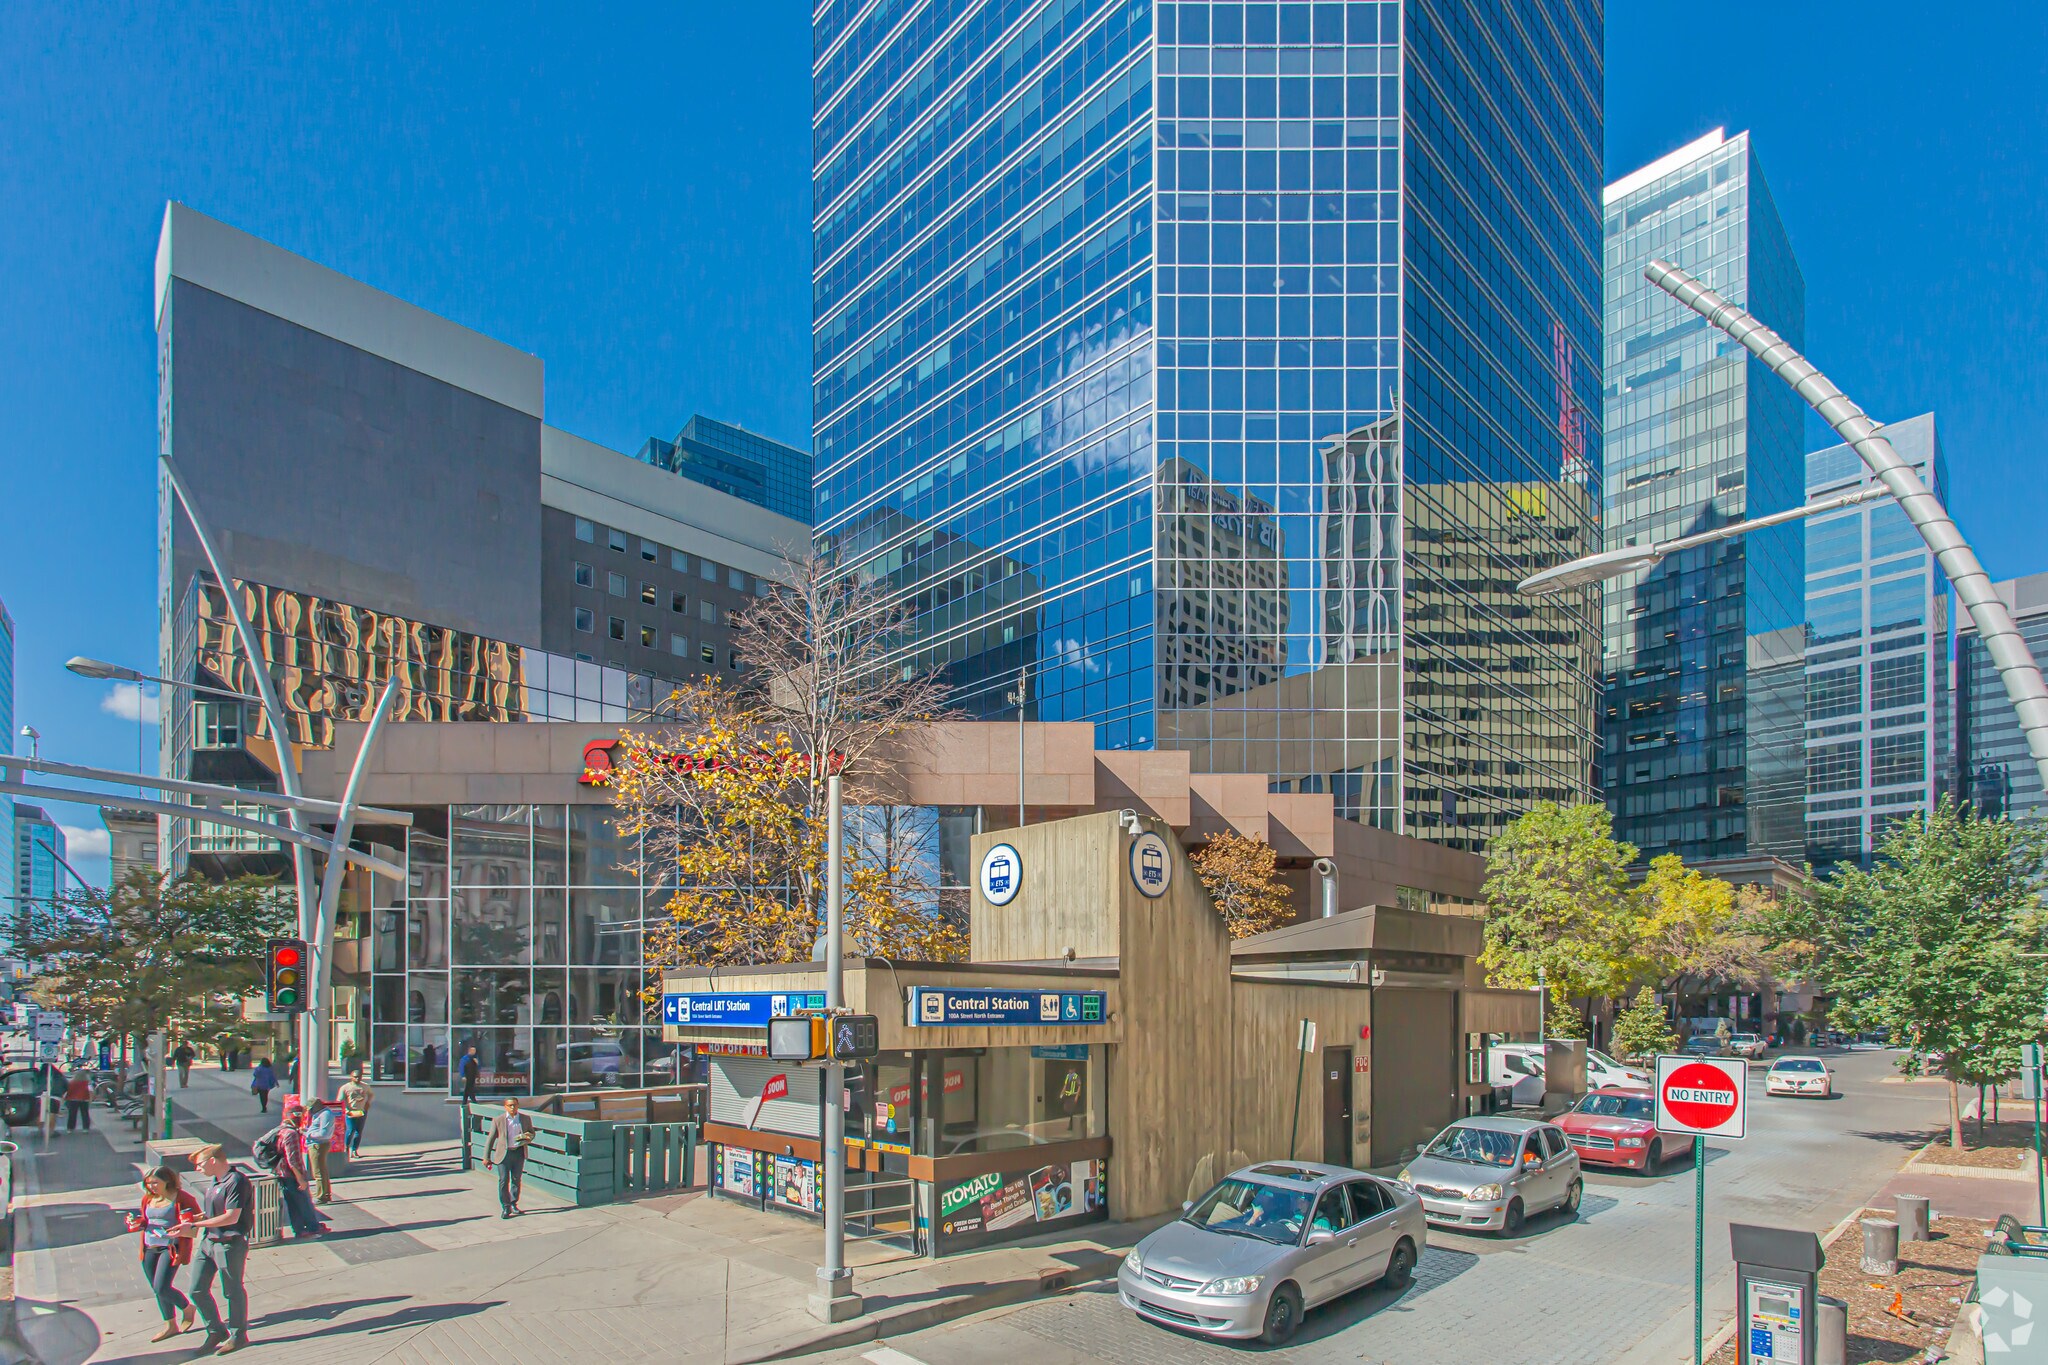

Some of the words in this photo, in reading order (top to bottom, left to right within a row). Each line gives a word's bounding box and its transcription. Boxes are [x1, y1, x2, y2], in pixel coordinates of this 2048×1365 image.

[1148, 870, 1157, 878] ETS
[995, 879, 1004, 887] ETS
[691, 1000, 713, 1012] Central
[714, 1000, 725, 1011] LRT
[727, 1000, 750, 1011] Station
[948, 997, 989, 1010] Central
[992, 997, 1029, 1010] Station
[708, 1043, 724, 1053] HOT
[727, 1044, 743, 1054] OFF
[746, 1045, 762, 1055] THE
[1356, 1057, 1368, 1067] FDC
[475, 1076, 528, 1084] cotiabank
[768, 1079, 785, 1095] SOON
[1671, 1089, 1689, 1101] NO
[1693, 1090, 1731, 1104] ENTRY
[1004, 1185, 1014, 1193] Top
[1003, 1192, 1019, 1203] Things
